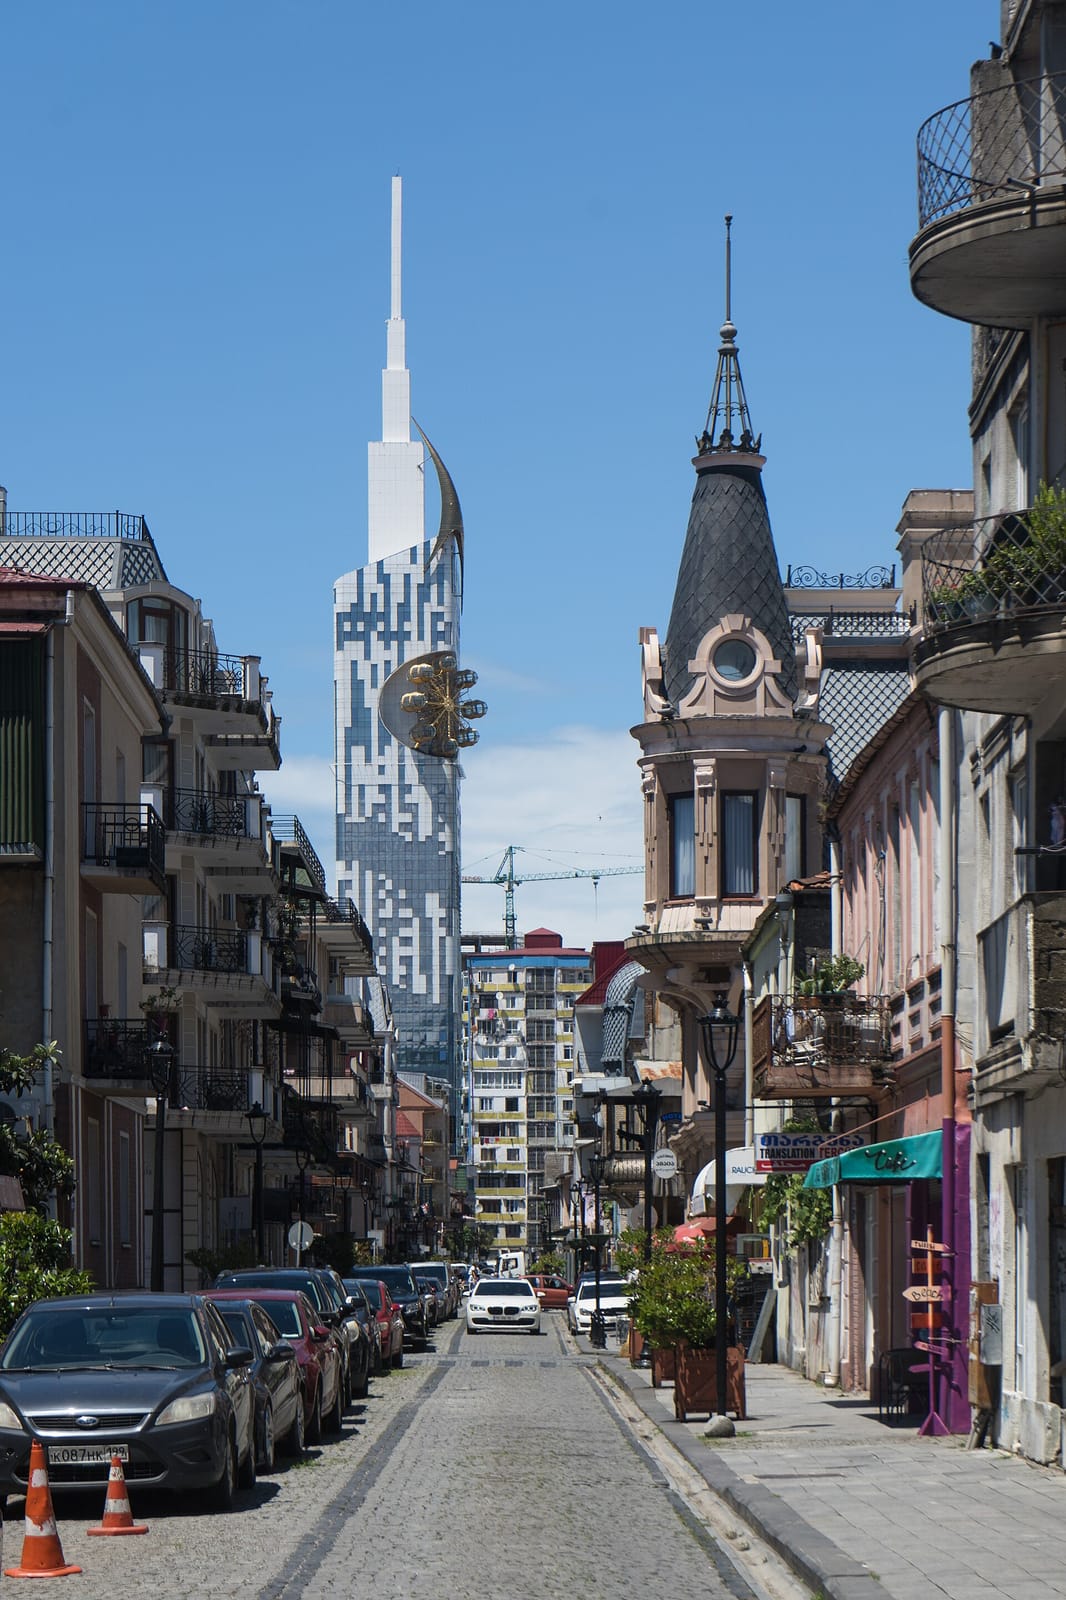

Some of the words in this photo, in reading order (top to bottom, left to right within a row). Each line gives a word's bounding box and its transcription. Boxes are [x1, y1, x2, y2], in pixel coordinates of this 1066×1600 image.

[760, 1148, 815, 1159] TRANSLATION
[819, 1147, 852, 1158] TERC
[911, 1287, 943, 1301] Beach
